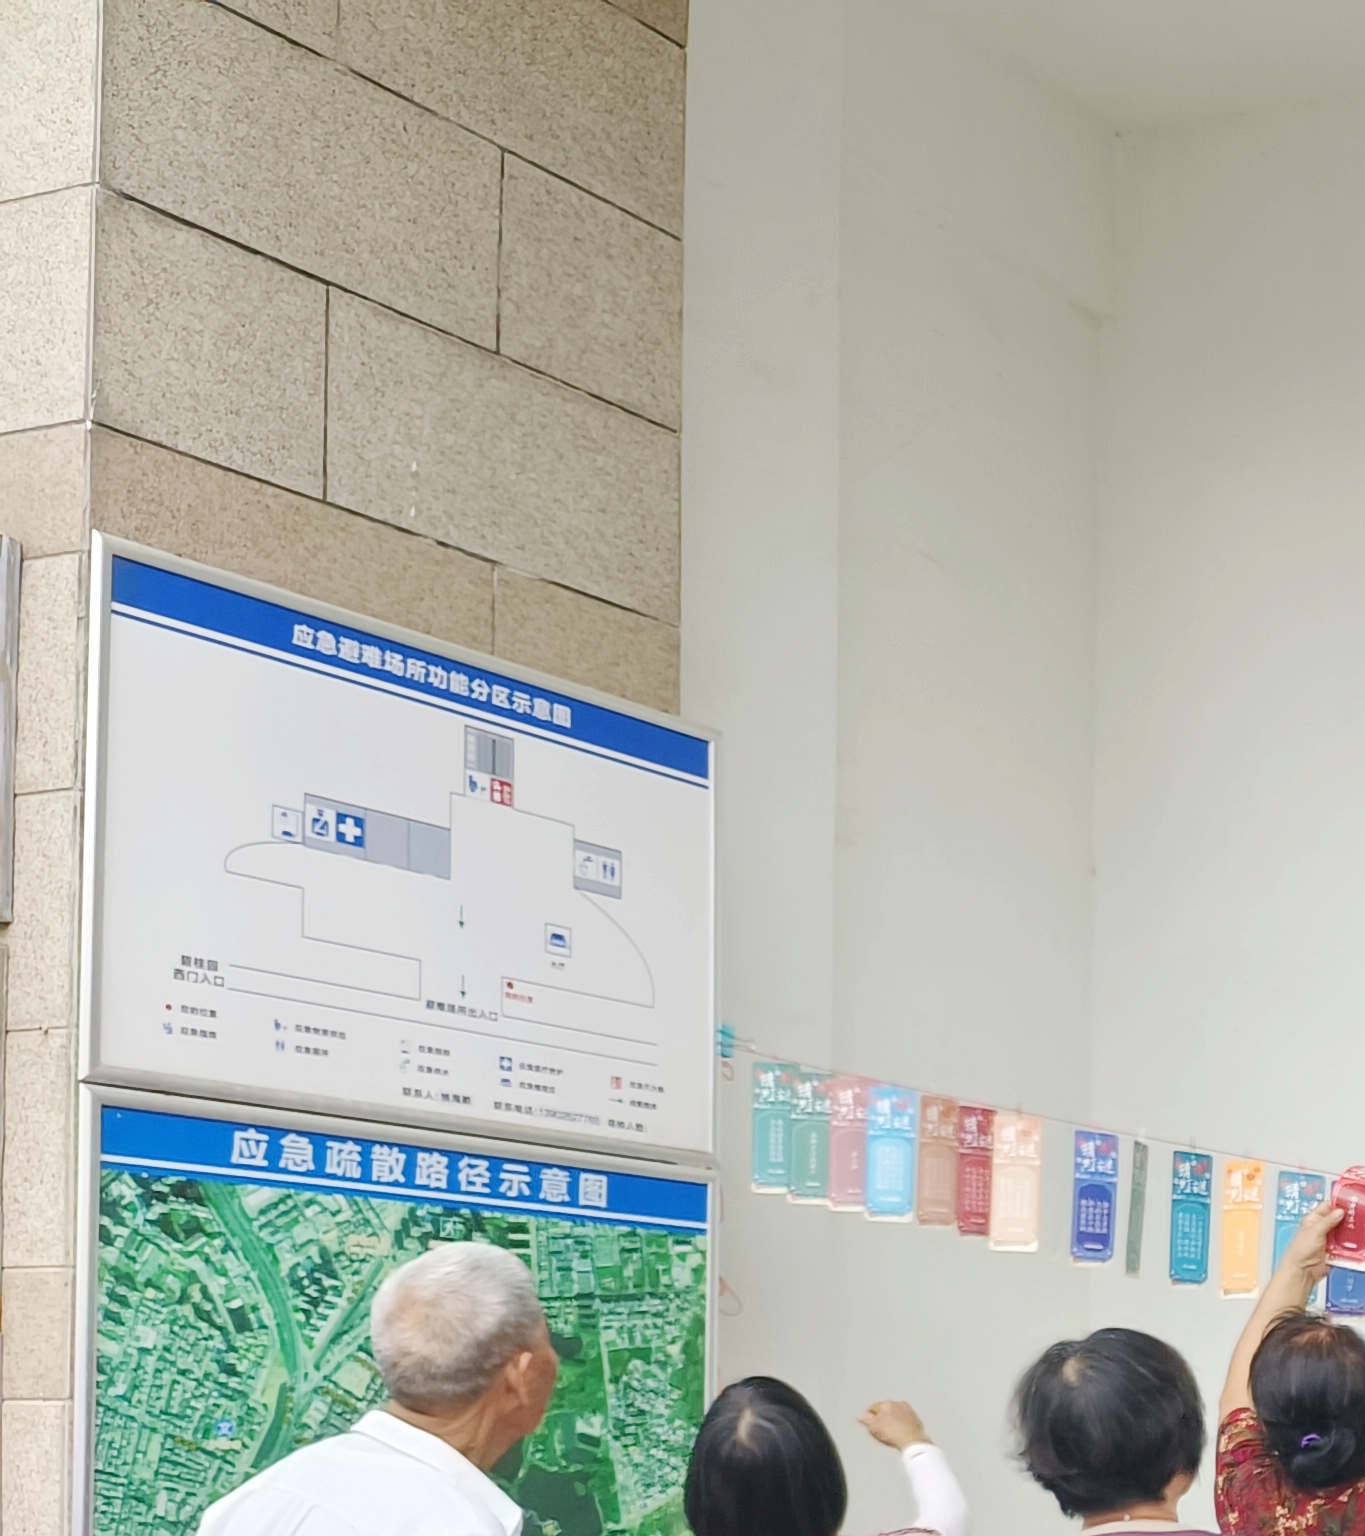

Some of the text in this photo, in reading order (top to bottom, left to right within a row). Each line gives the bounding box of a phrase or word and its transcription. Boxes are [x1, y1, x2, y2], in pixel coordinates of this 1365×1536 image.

[292, 623, 572, 729] 应急避难场所功能分区示意图
[173, 968, 225, 988] 西门入口
[230, 1129, 609, 1209] 应急疏散路径示意图
